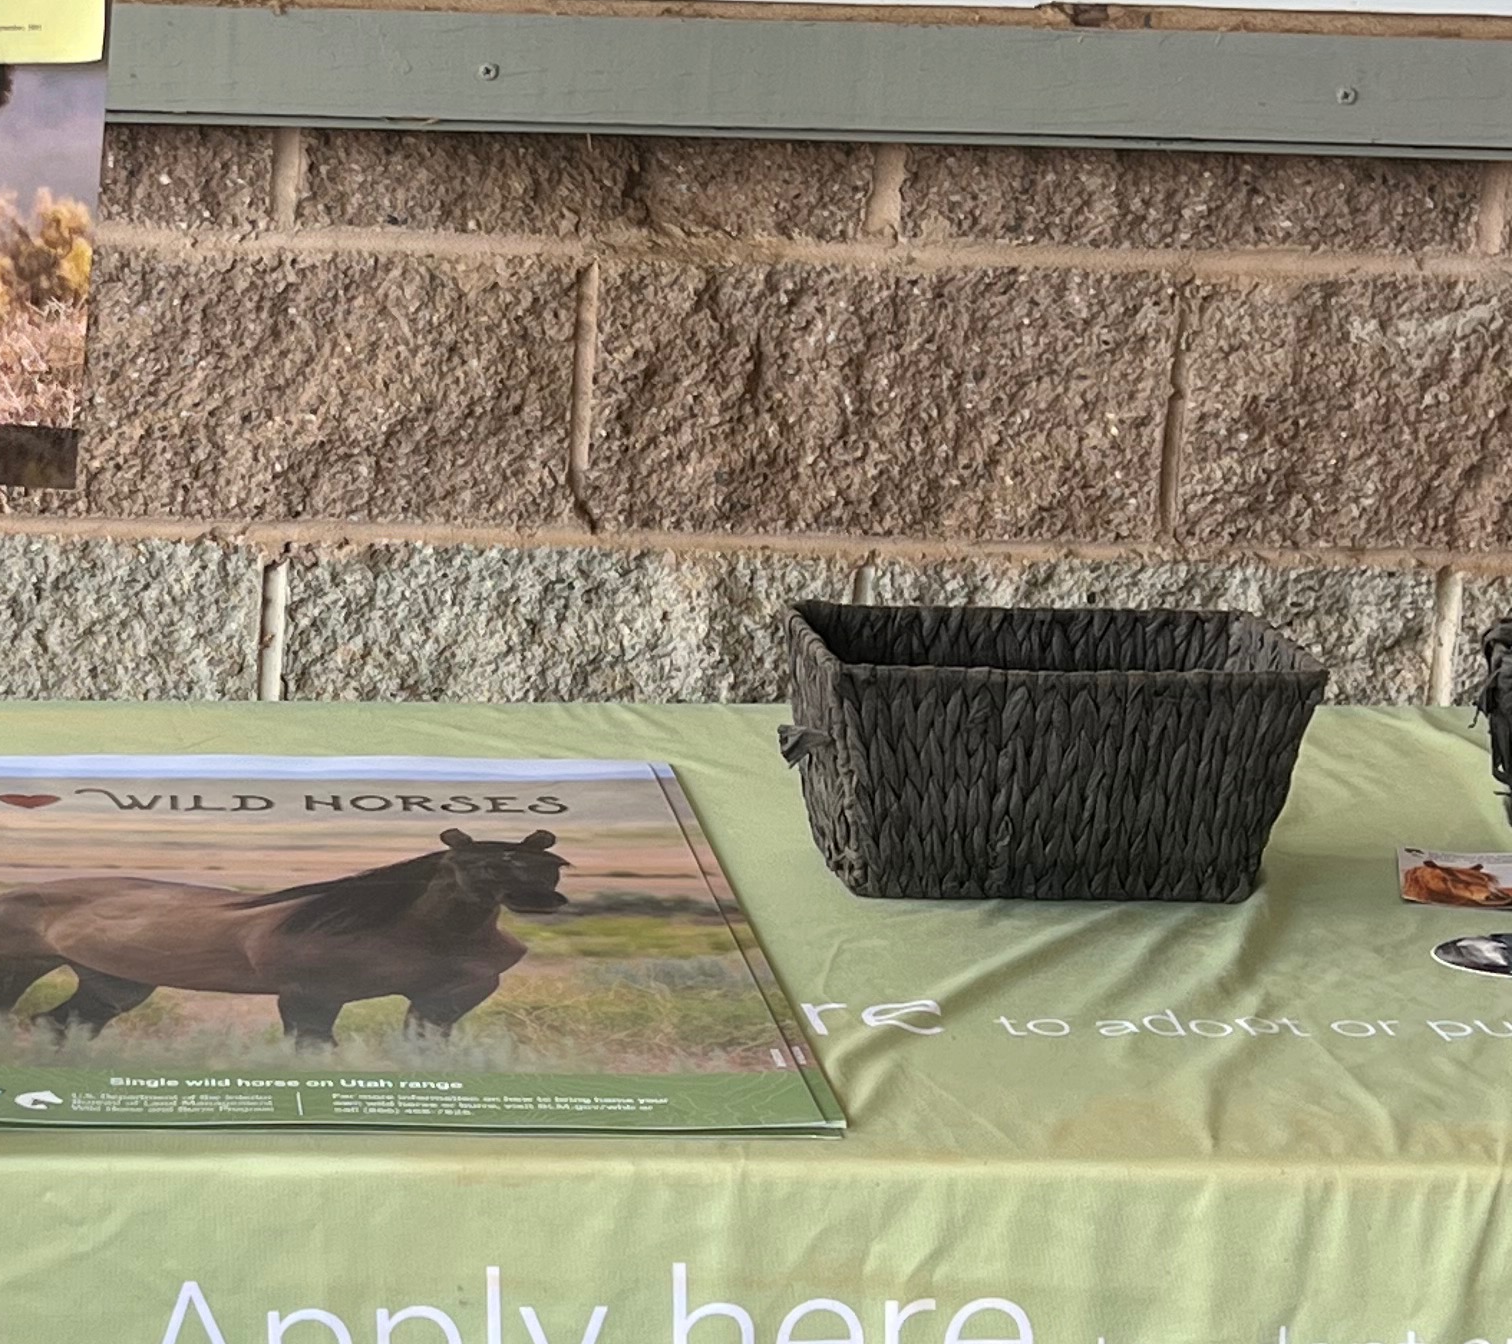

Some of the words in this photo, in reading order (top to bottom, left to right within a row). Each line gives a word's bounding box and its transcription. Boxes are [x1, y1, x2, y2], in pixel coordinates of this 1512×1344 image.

[76, 787, 275, 816] WILD
[303, 791, 570, 818] HORSES
[992, 1012, 1072, 1038] to
[1094, 1008, 1314, 1040] adopt
[1330, 1014, 1399, 1038] or
[109, 1076, 180, 1089] Single
[185, 1076, 231, 1088] wild
[236, 1077, 301, 1088] horse
[305, 1079, 334, 1088] on
[339, 1078, 393, 1089] Utah
[399, 1080, 464, 1091] range
